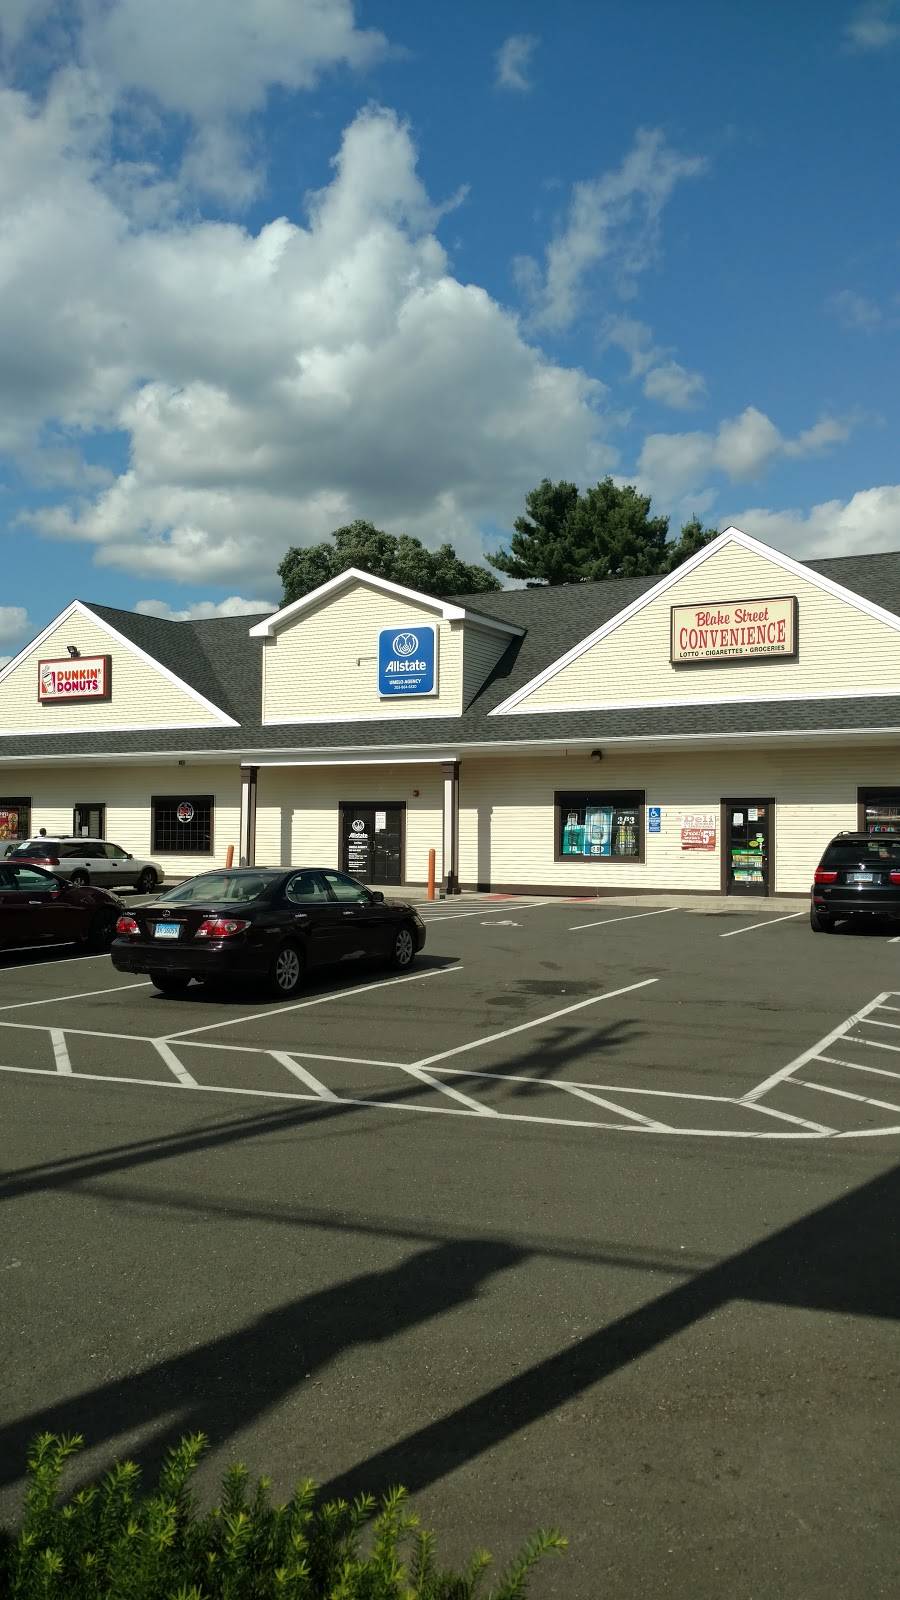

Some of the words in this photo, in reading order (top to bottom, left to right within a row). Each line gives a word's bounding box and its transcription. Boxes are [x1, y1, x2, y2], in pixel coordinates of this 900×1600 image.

[695, 610, 730, 627] Blake
[734, 607, 769, 624] Street
[679, 619, 786, 650] CONVENIENCE
[705, 647, 744, 656] CIGARETTES
[749, 644, 785, 653] GROCERIES
[385, 659, 427, 672] Allstate
[57, 668, 101, 681] DUNKIN'
[57, 680, 98, 692] DONUTS
[683, 815, 714, 823] Deli
